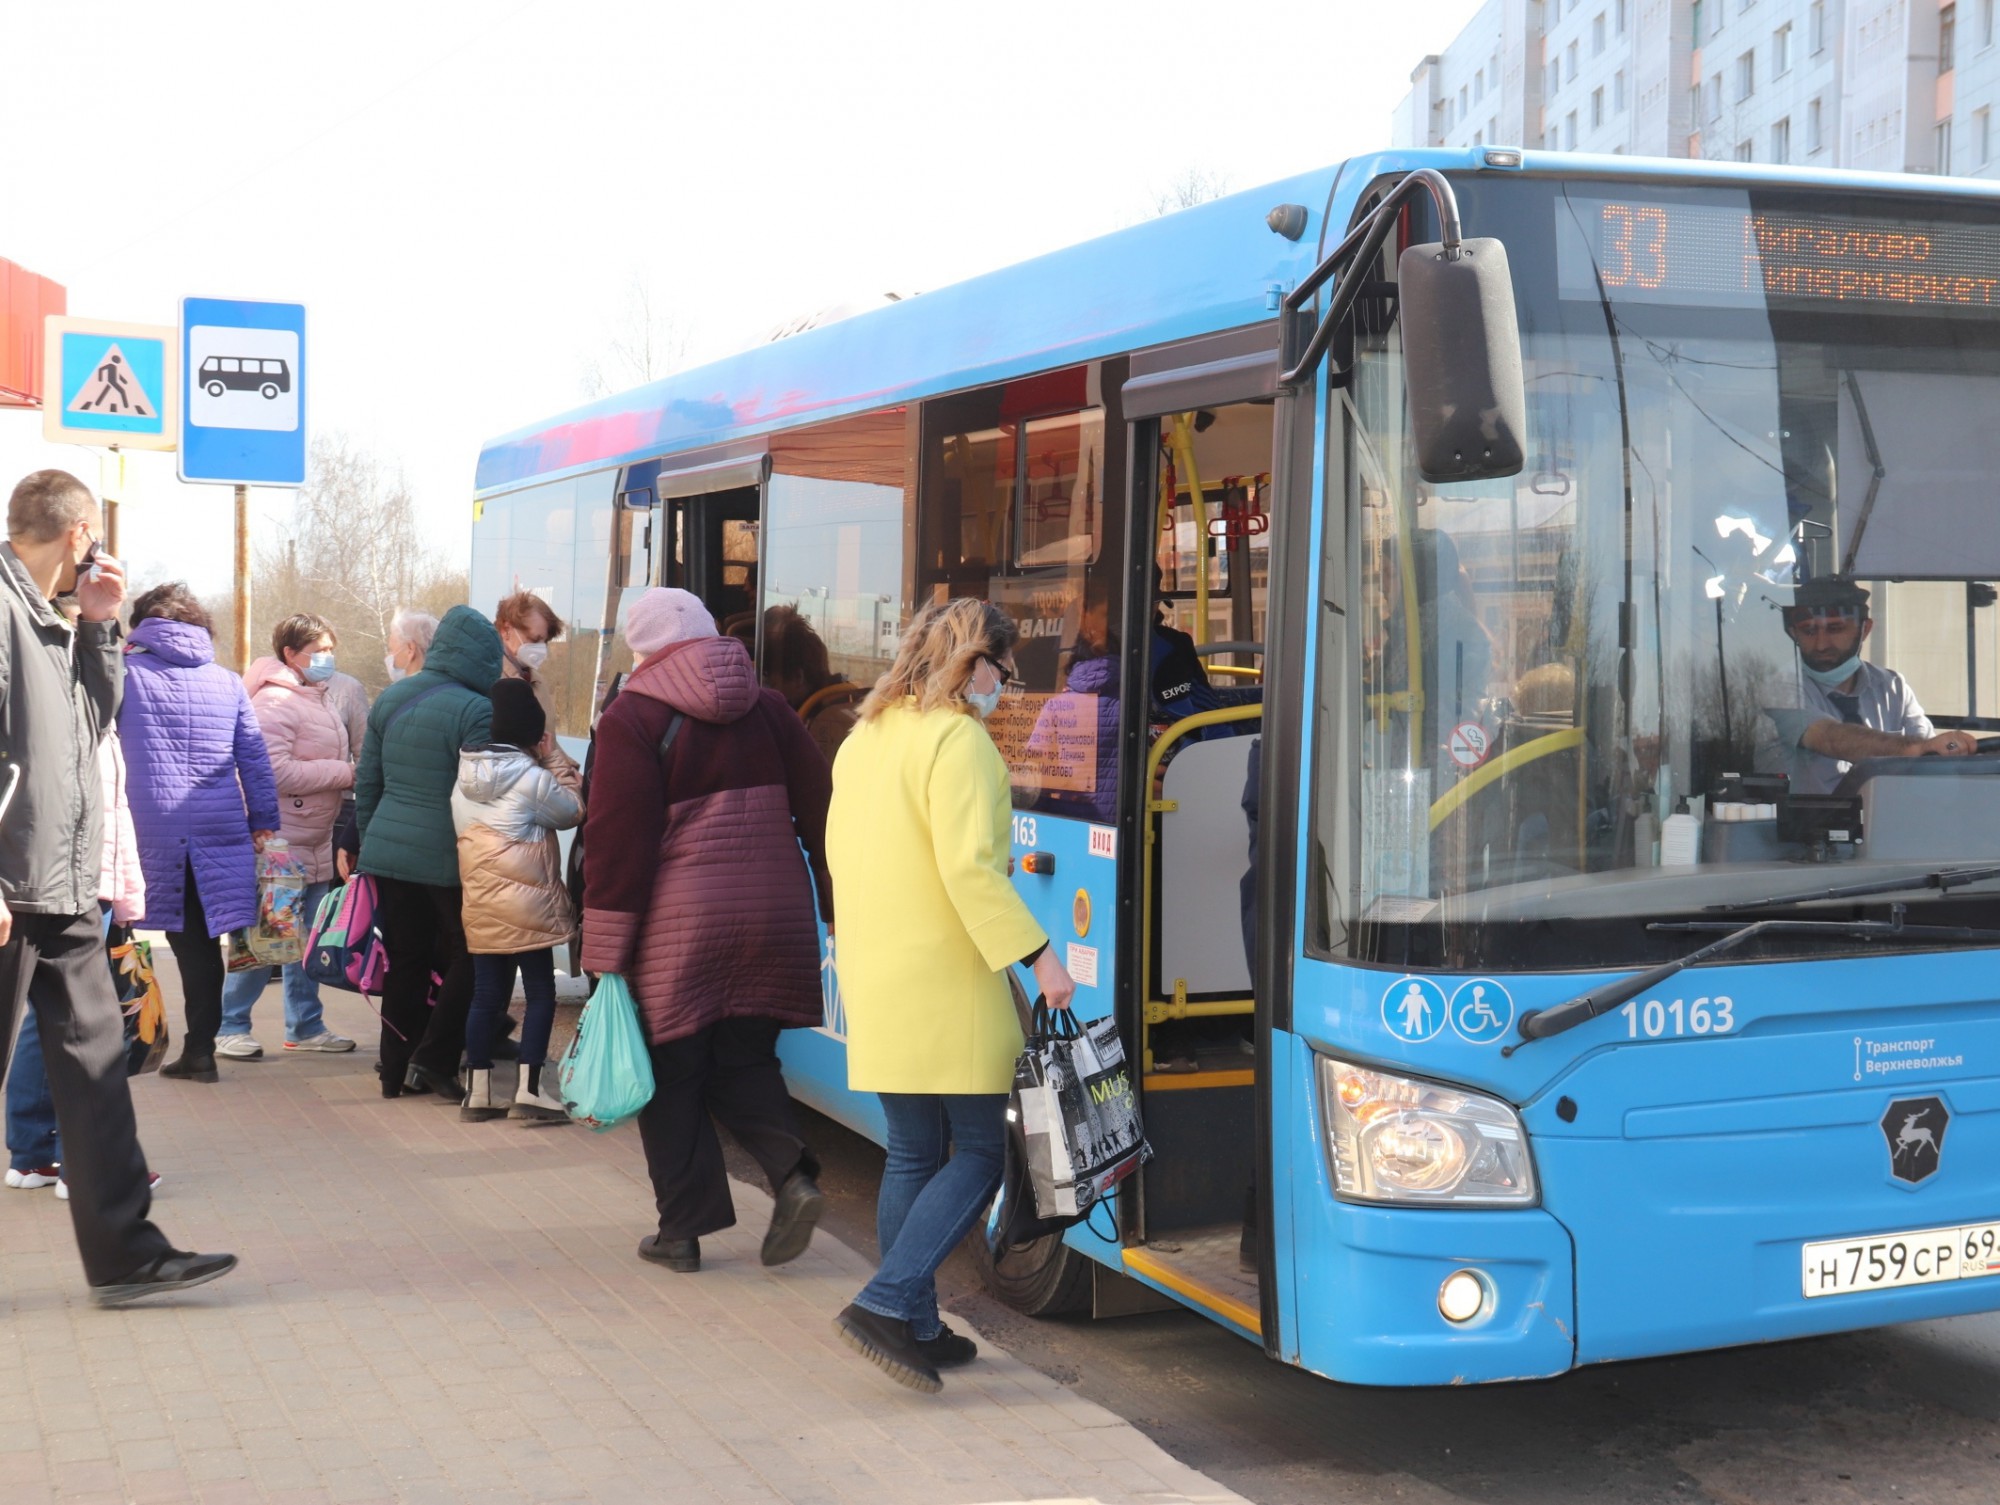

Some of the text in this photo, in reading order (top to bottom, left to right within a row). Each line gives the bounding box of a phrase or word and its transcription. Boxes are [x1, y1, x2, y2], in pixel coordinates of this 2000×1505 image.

[1602, 204, 1667, 289] 33
[1743, 214, 1931, 261] Мигалово
[1742, 254, 2000, 304] Гипермаркет
[1054, 731, 1095, 746] Терешковой
[1059, 747, 1085, 762] Ленина
[1038, 762, 1073, 778] Мигалово
[1092, 831, 1112, 855] ВХОД
[1620, 995, 1735, 1039] 10163
[1865, 1038, 1935, 1055] Транспорт
[1865, 1053, 1963, 1075] Верхневолжья
[1965, 1229, 1995, 1260] 69
[1961, 1260, 1986, 1272] RUS
